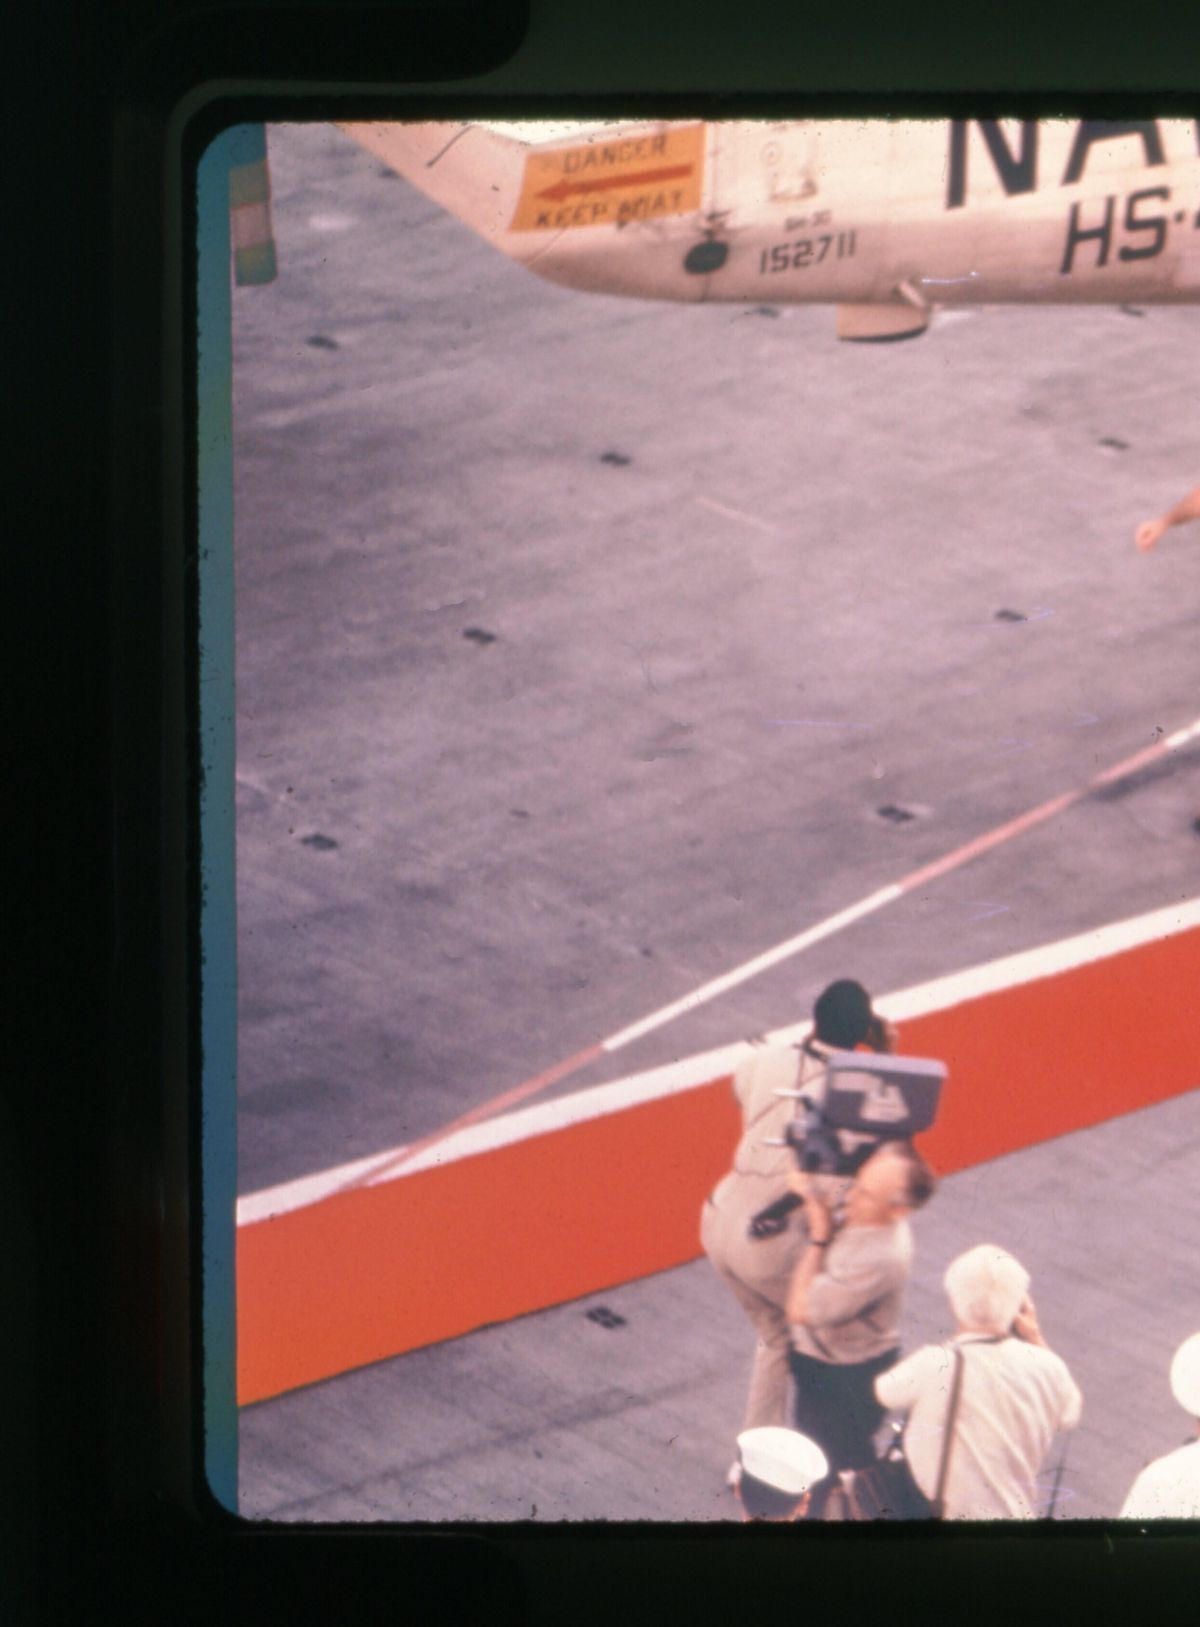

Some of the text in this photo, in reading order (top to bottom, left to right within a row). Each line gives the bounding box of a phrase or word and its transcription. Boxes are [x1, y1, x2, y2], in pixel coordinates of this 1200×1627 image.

[563, 132, 668, 174] DANGER
[535, 202, 609, 227] KEEP
[759, 229, 857, 274] 152711
